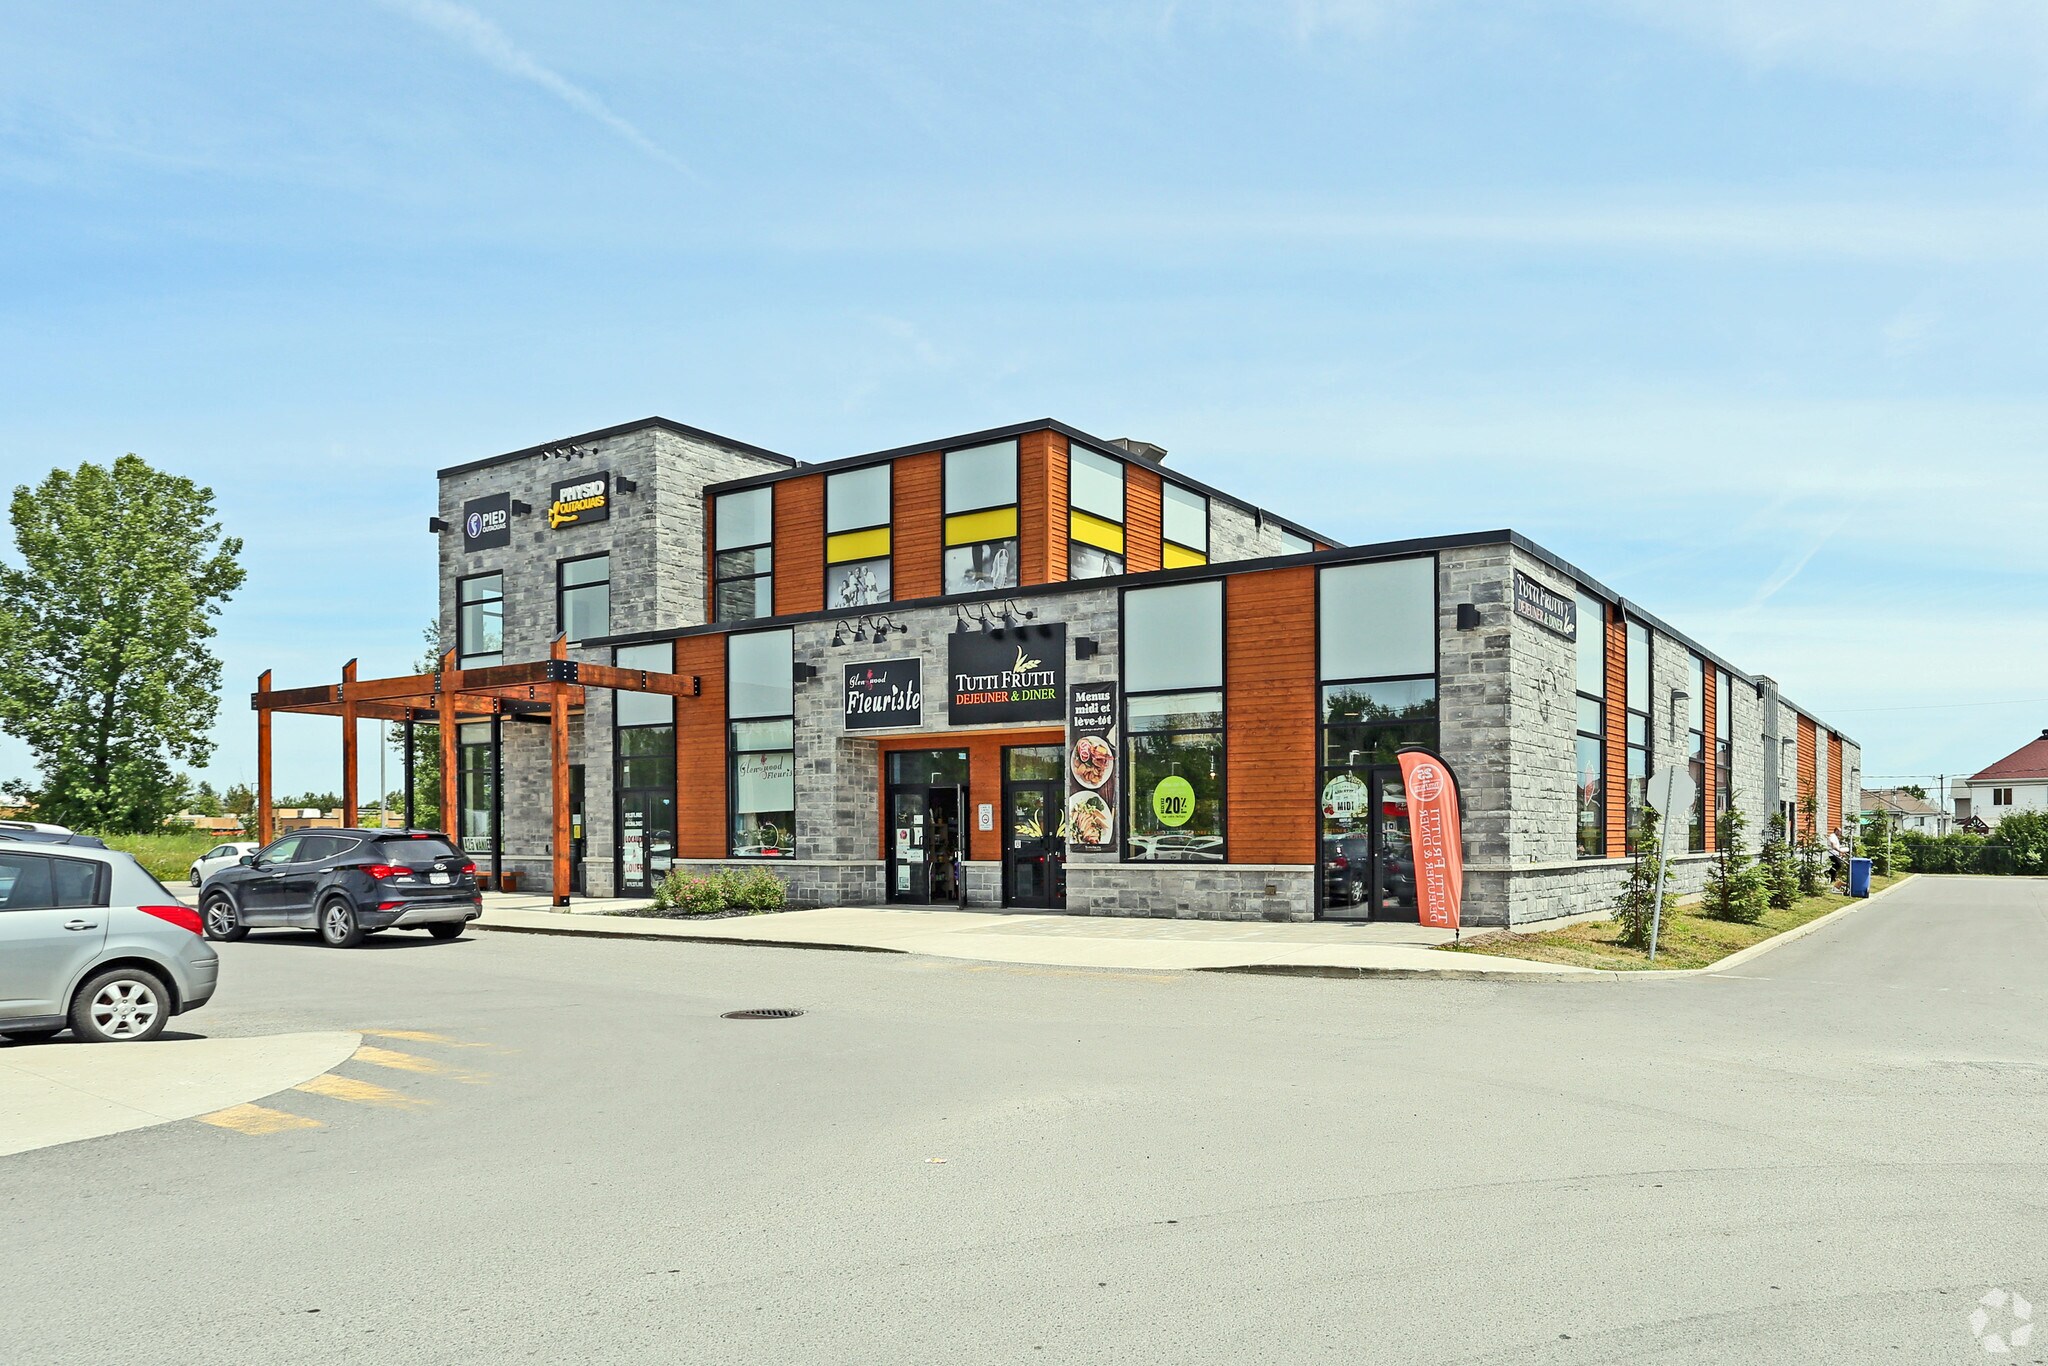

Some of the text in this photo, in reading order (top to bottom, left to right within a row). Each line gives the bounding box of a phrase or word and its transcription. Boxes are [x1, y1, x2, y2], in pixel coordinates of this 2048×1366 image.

[560, 480, 605, 502] PHYSIO
[560, 496, 605, 514] OUTAOUAIS
[482, 510, 506, 527] PIED
[1517, 573, 1564, 617] TUTTI FRUTTI
[955, 670, 1056, 692] TUTTI FRUTTI
[846, 680, 920, 715] Fleuriste
[956, 688, 1056, 705] DEJEUNER & DINER
[1075, 692, 1111, 702] Menus
[1074, 702, 1111, 714] midi et
[1337, 801, 1354, 811] MIDI
